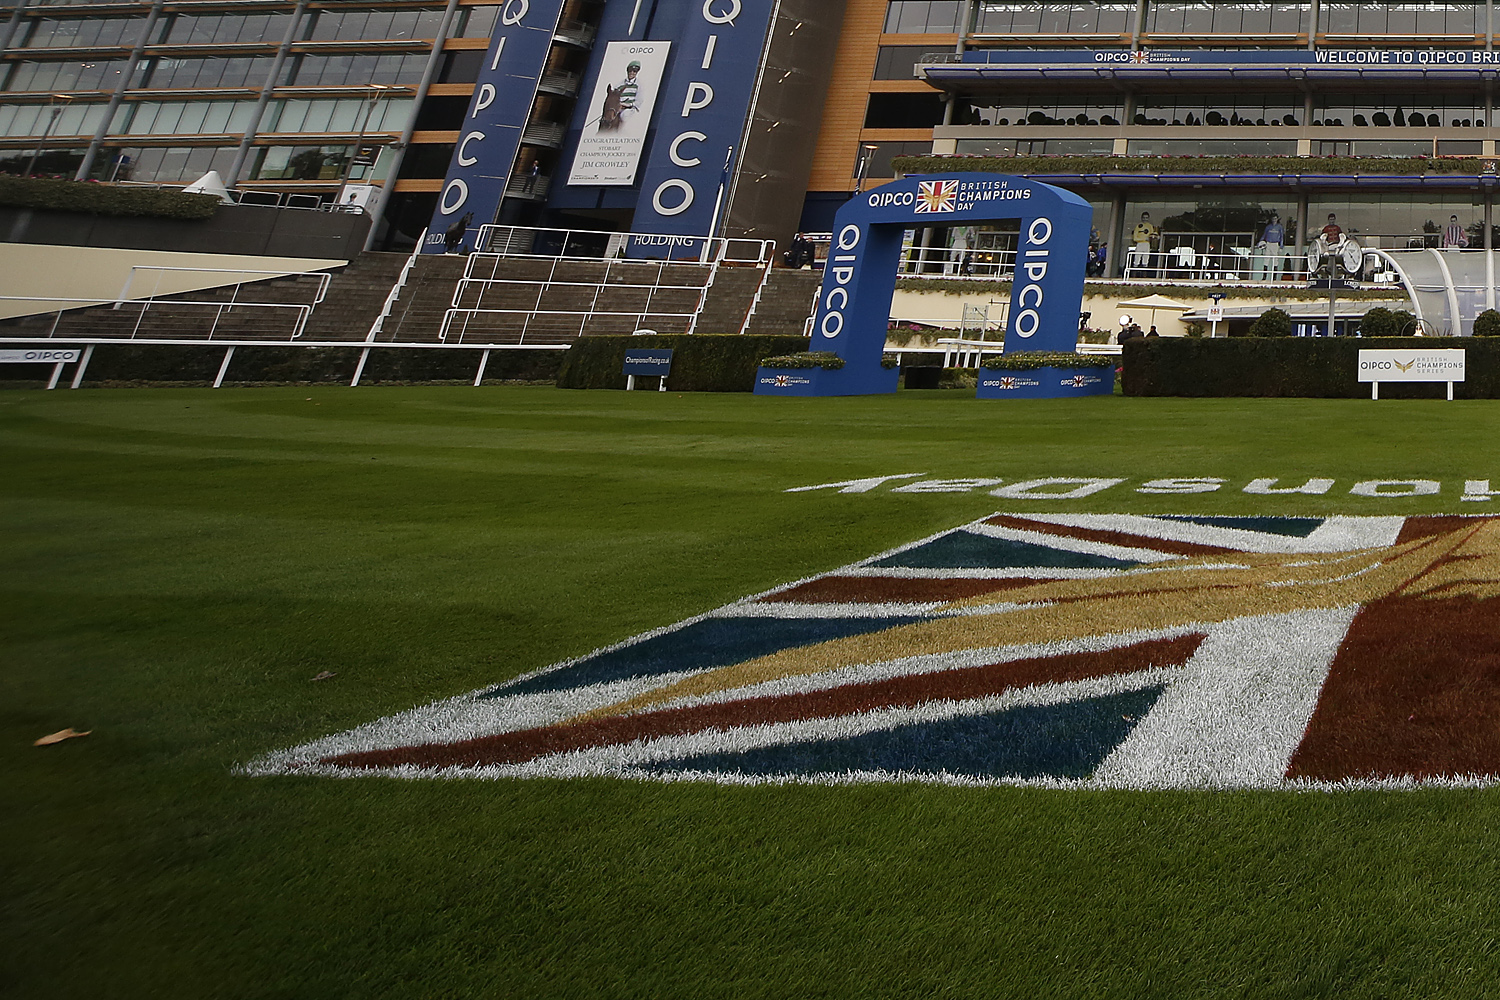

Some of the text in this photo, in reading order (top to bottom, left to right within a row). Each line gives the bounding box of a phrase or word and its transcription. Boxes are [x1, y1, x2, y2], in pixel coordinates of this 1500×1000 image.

[1095, 53, 1129, 62] QIPCO
[1315, 51, 1389, 63] WELCOME
[1394, 51, 1413, 63] TO
[1418, 51, 1466, 65] QIPCO
[581, 161, 594, 169] JIM
[961, 181, 1008, 190] BRITISH
[868, 191, 914, 207] QIPCO
[959, 189, 1031, 202] CHAMPIONS
[957, 202, 974, 211] DAY
[633, 235, 694, 247] HOLDING
[820, 224, 861, 339] QIPCO
[1015, 217, 1053, 339] QIPCO
[25, 351, 74, 360] QIPCO
[1360, 361, 1392, 370] QIPCO
